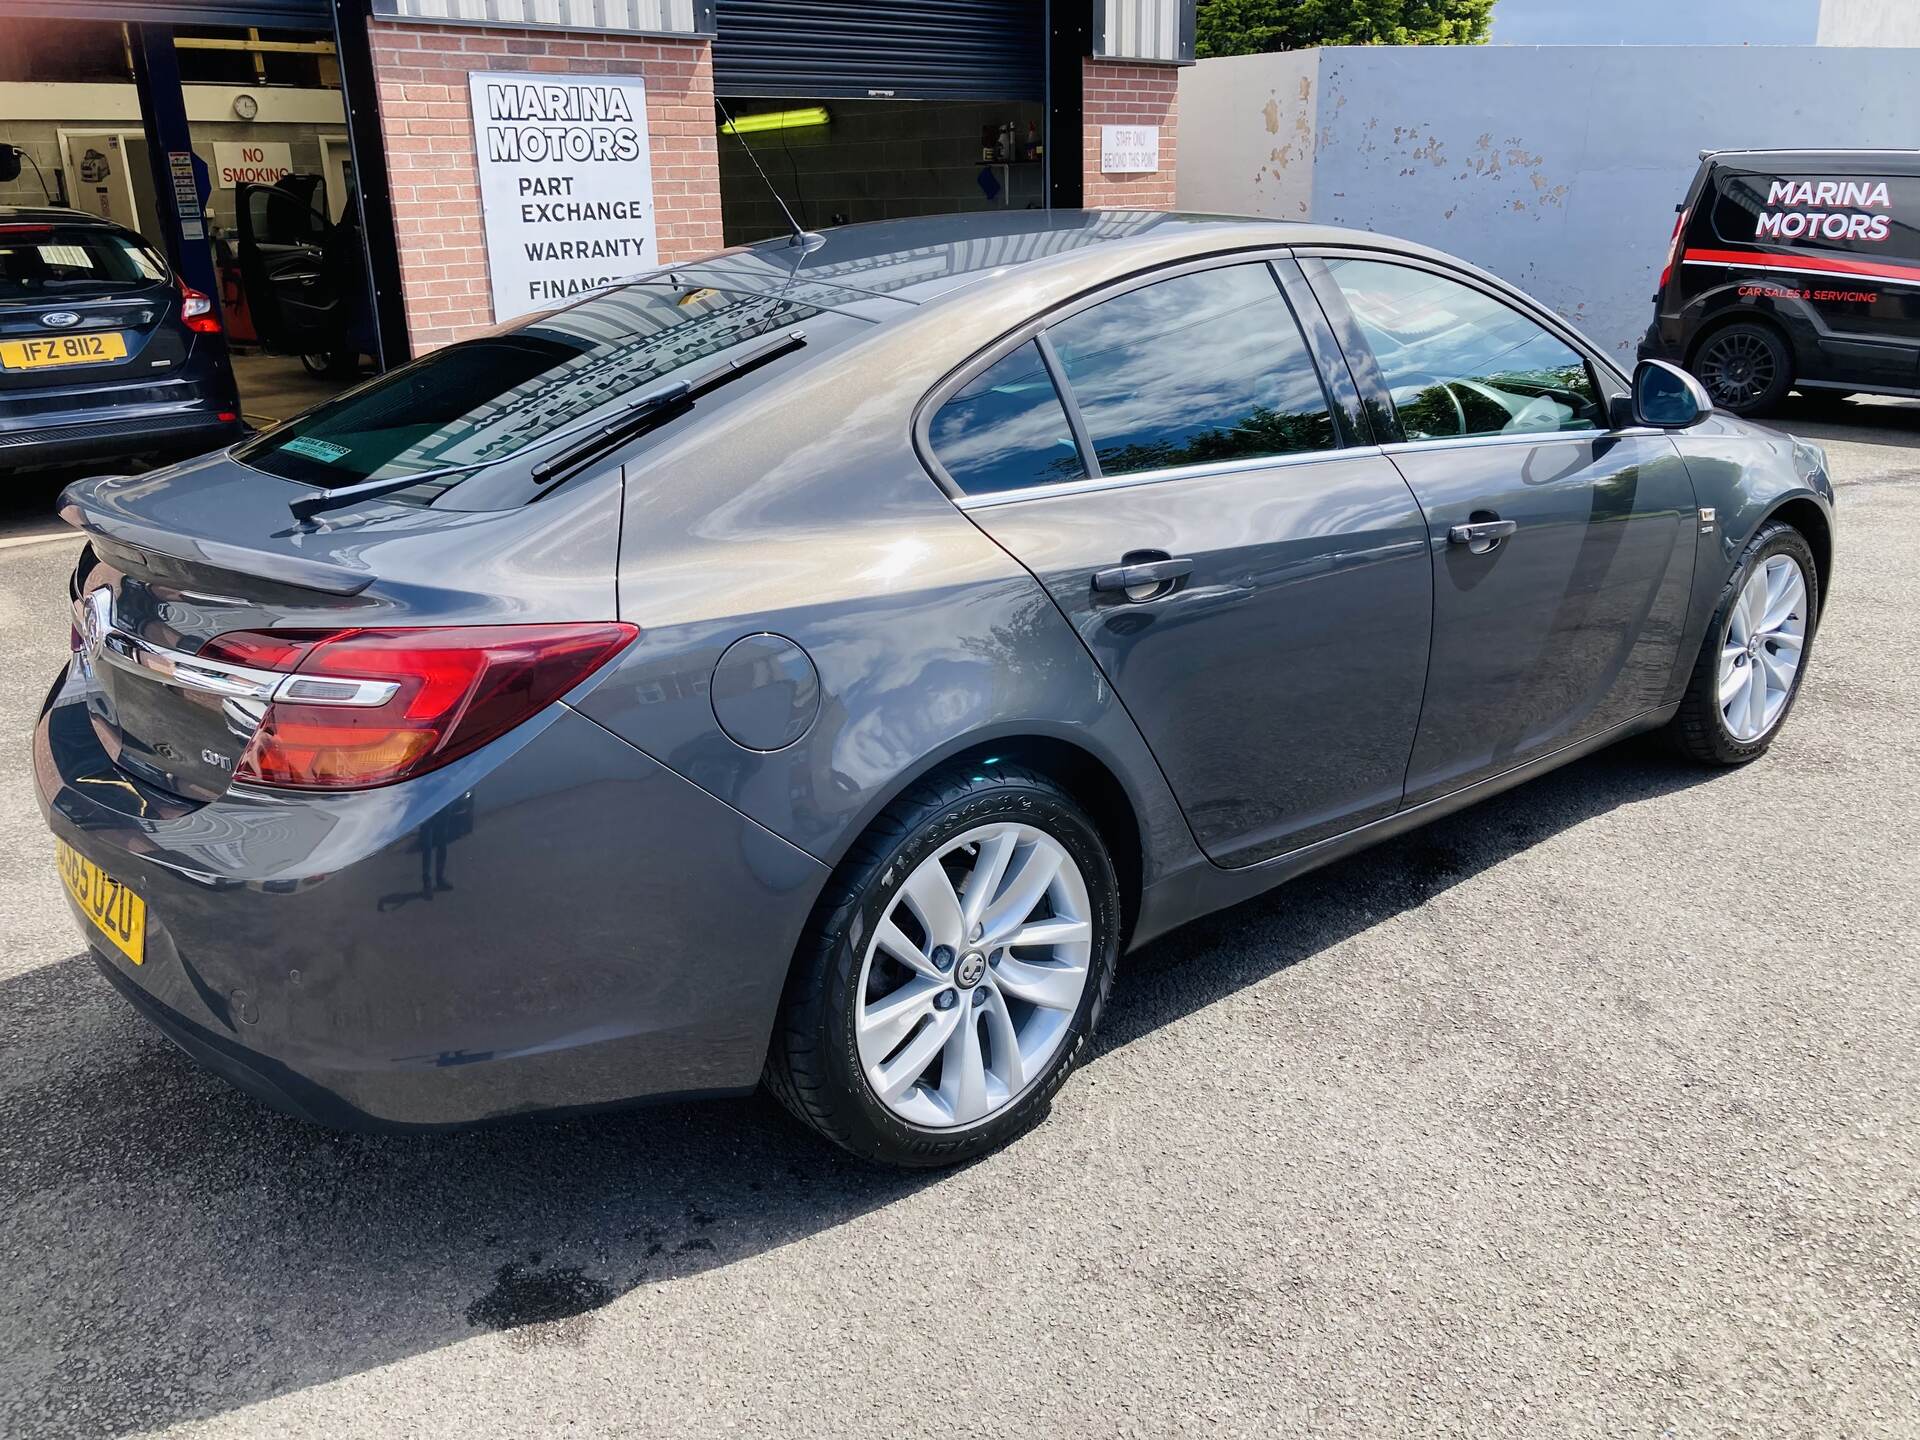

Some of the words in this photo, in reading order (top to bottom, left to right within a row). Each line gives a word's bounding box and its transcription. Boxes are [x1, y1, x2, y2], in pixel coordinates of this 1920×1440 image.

[487, 84, 633, 122] MARINA
[242, 148, 264, 162] NO
[487, 126, 640, 162] MOTORS
[518, 177, 574, 196] PART
[1767, 181, 1892, 208] MARINA
[521, 201, 642, 223] EXCHANGE
[1755, 212, 1892, 240] MOTORS
[524, 238, 645, 262] WARRANTY
[529, 275, 624, 300] FINANC
[1738, 286, 1762, 298] CAR
[1763, 288, 1800, 299] SALES
[1802, 290, 1810, 300] &
[1812, 291, 1877, 303] SERVICING
[22, 341, 59, 361] IFZ
[63, 337, 105, 357] 8112
